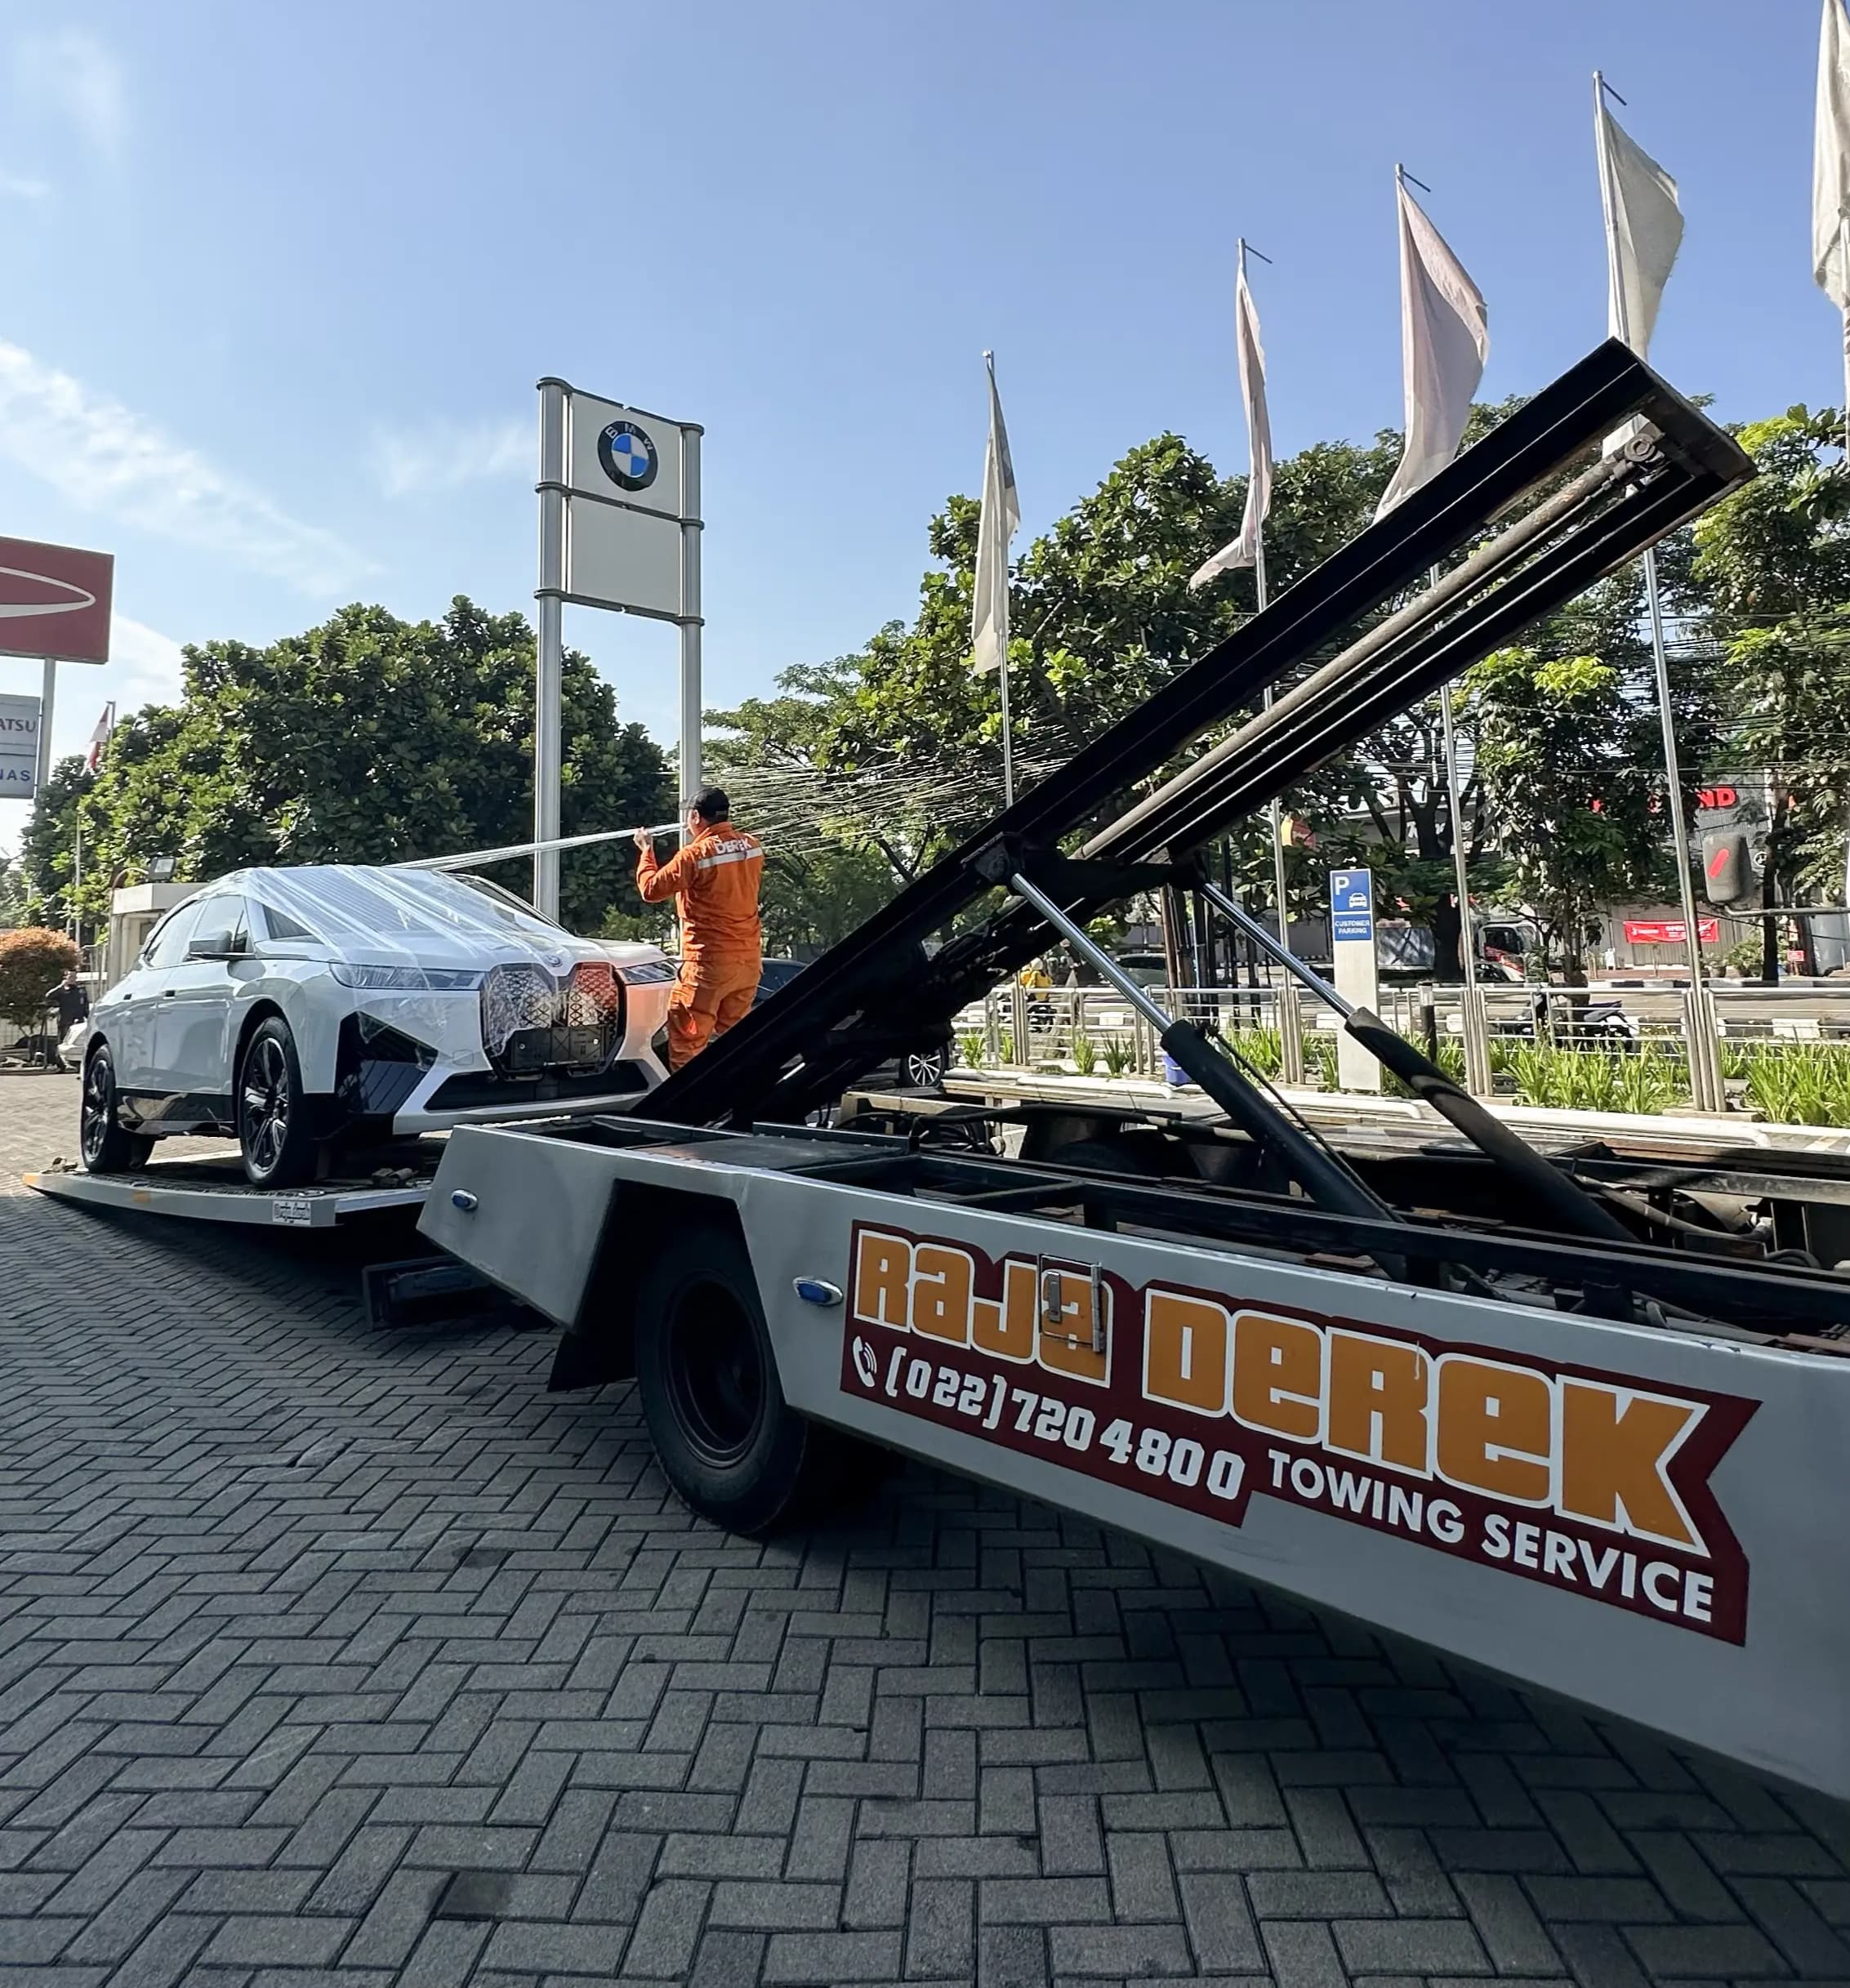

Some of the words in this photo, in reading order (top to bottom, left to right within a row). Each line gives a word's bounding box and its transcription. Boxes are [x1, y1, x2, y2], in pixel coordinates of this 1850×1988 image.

[604, 422, 654, 451] BMW
[1335, 876, 1350, 896] P
[1099, 1419, 1246, 1500] 4800
[1268, 1449, 1464, 1543] TOWING
[1482, 1514, 1714, 1622] SERVICE
